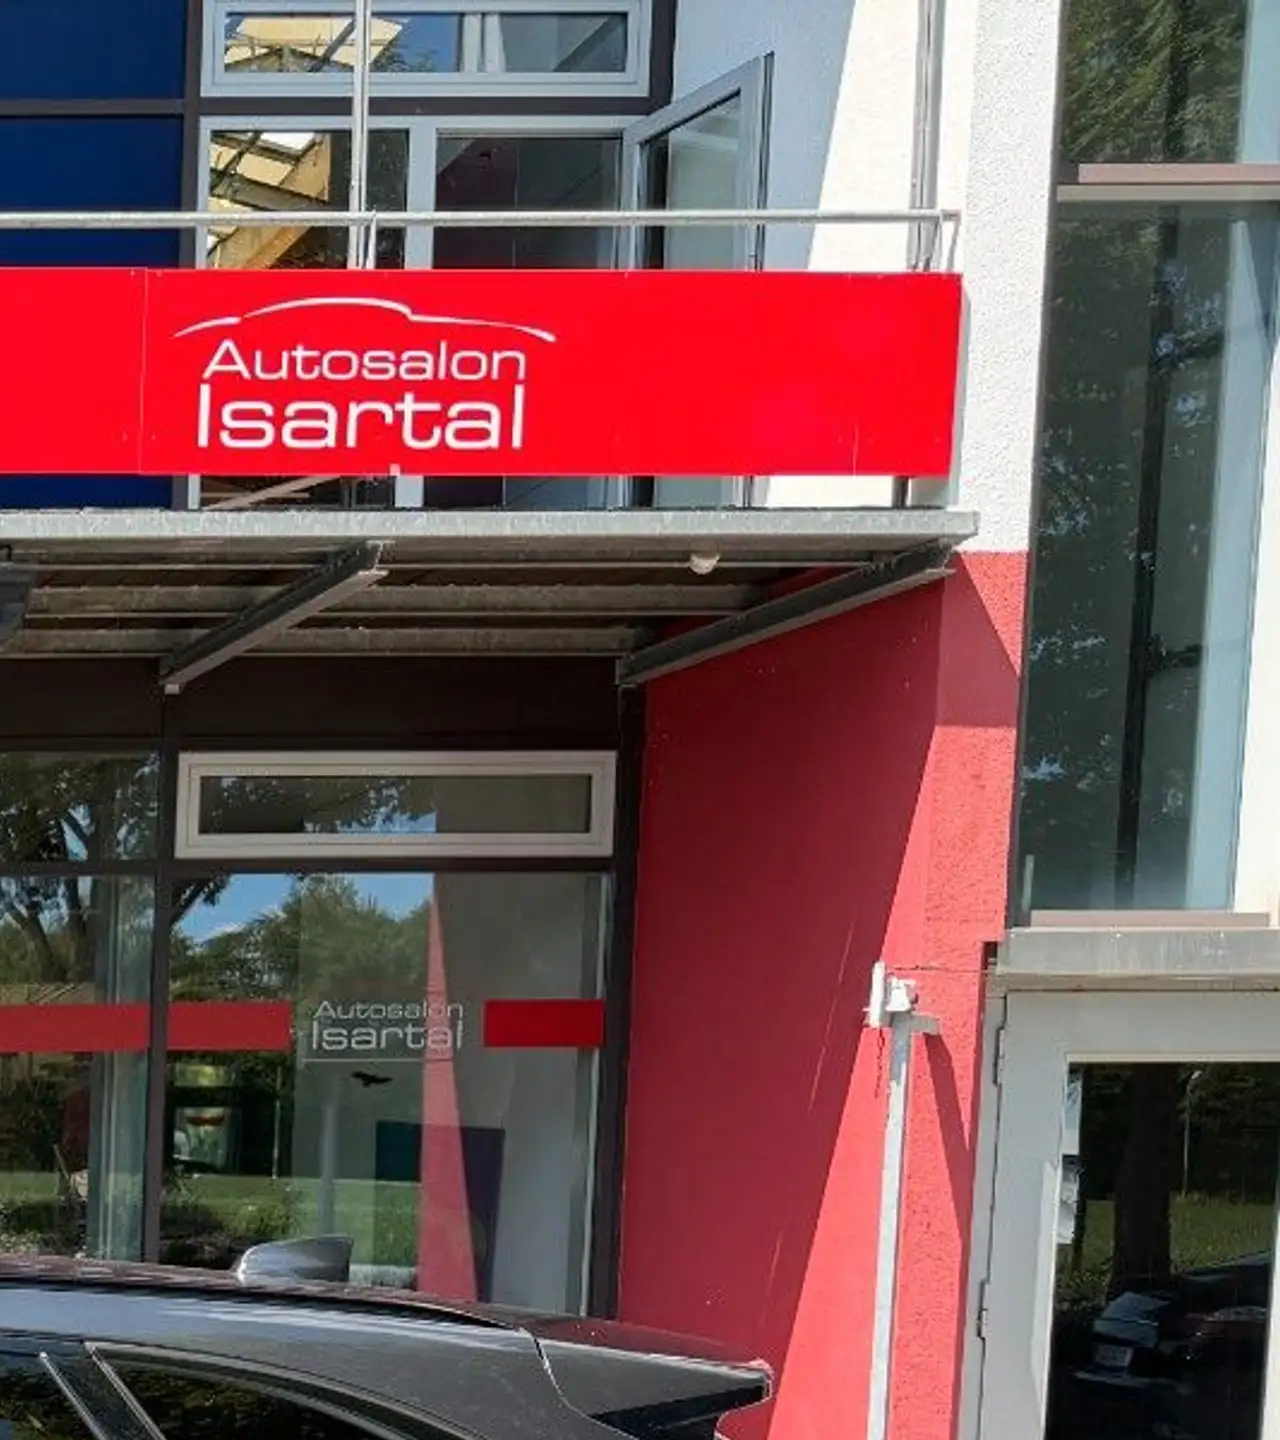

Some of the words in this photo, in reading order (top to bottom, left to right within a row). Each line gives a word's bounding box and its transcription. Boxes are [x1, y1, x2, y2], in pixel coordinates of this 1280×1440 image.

[202, 339, 526, 380] Autosalon
[197, 383, 525, 449] Isartal
[313, 1000, 463, 1019] Autosalon
[313, 1020, 463, 1050] Isartal
